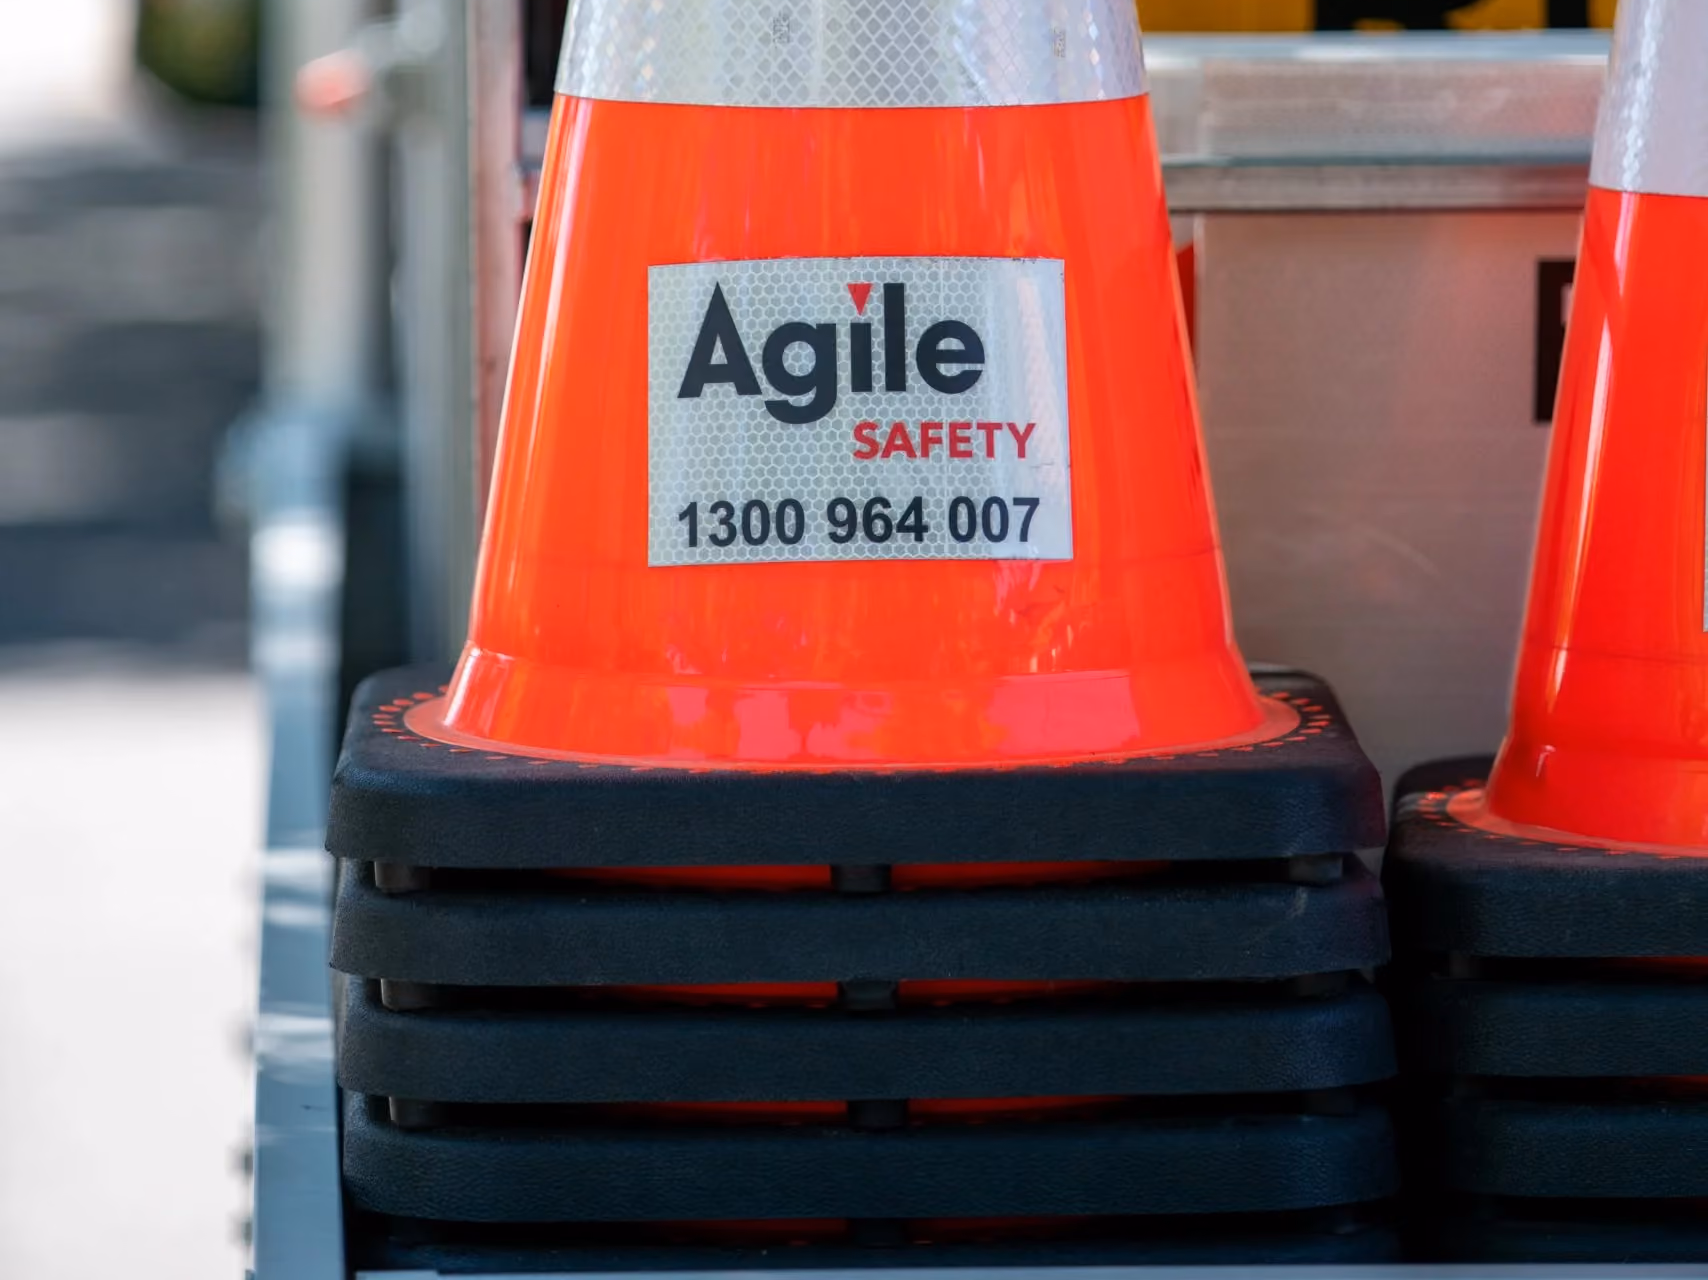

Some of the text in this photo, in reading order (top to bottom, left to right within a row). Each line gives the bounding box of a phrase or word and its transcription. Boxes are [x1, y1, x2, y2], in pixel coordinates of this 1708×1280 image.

[677, 281, 986, 425] Agile
[852, 421, 1036, 460] SAFETY
[678, 495, 1040, 548] 1300 964 007
